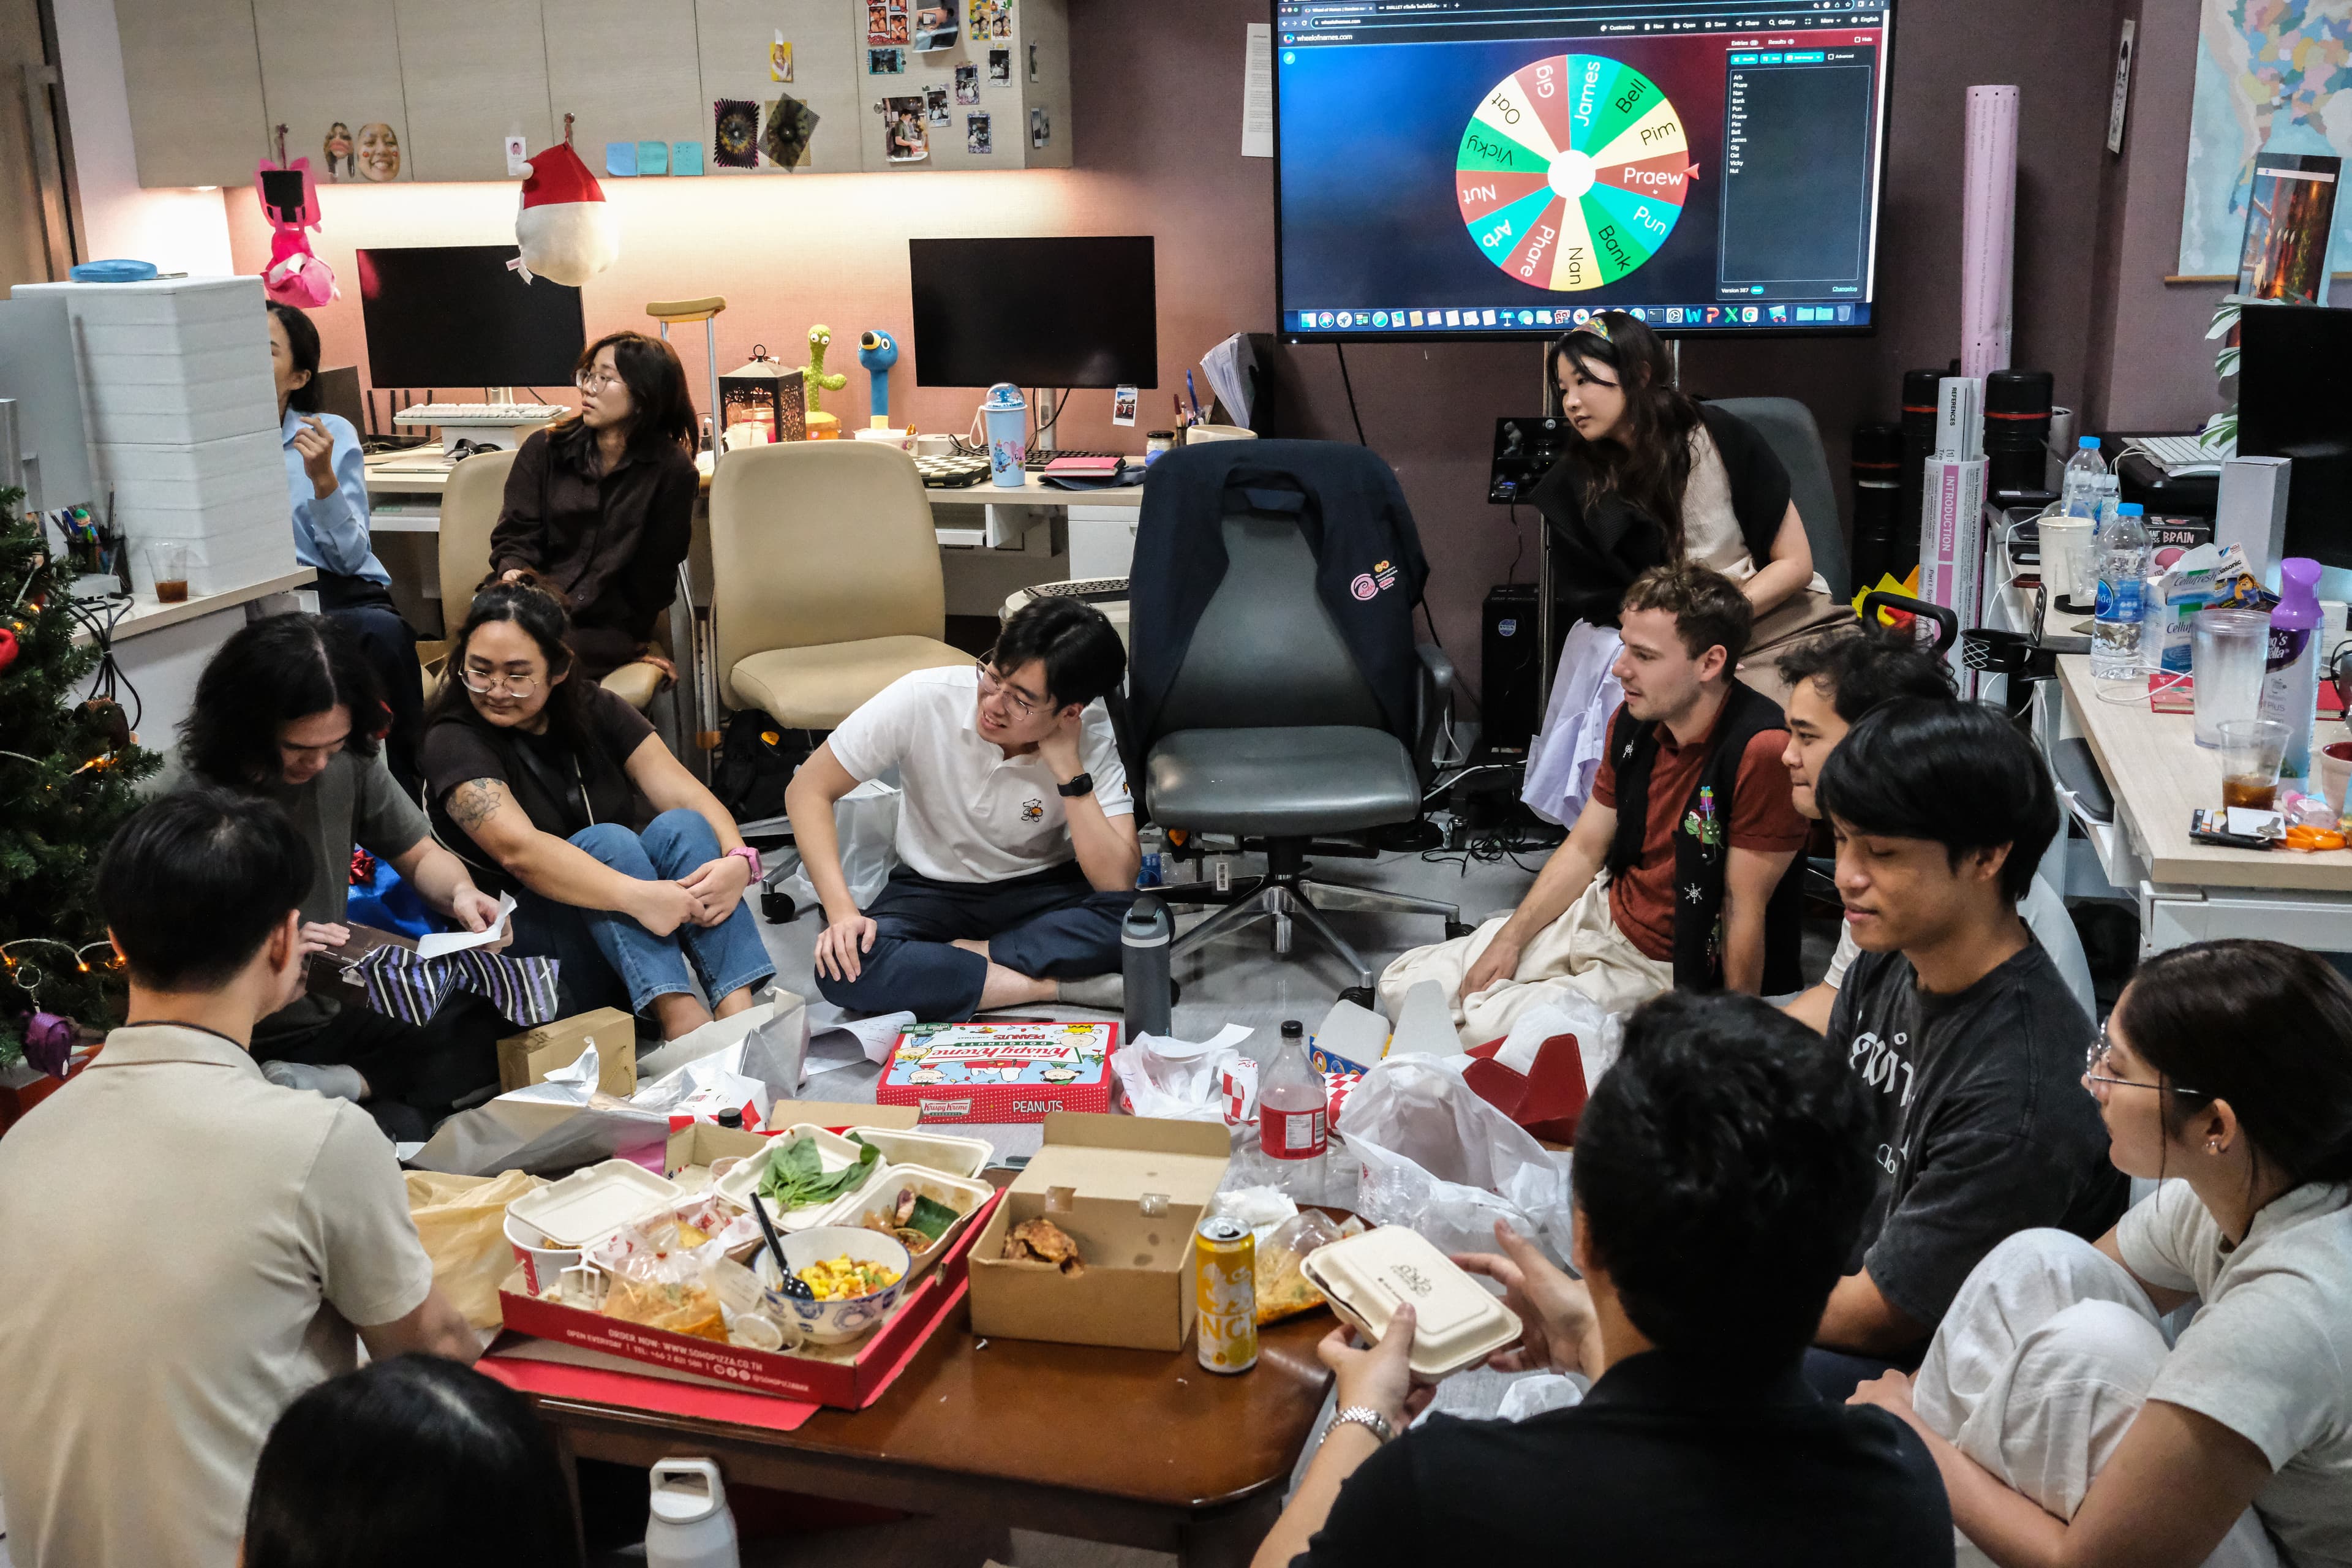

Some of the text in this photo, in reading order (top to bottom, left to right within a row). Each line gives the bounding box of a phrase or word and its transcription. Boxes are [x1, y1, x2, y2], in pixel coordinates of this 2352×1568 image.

[1536, 65, 1555, 98] Gig
[1574, 61, 1600, 127] James
[1615, 78, 1647, 113] Bell
[1491, 92, 1520, 124] Oat
[1641, 122, 1676, 145] Pim
[1467, 135, 1513, 166] Vicky
[1624, 167, 1683, 186] Praew
[1463, 184, 1496, 204] Nut
[1634, 206, 1666, 235] Pun
[1483, 219, 1512, 247] Arb
[1520, 225, 1555, 277] Phare
[1599, 225, 1631, 271] Bank
[1569, 247, 1583, 284] Nan
[1946, 449, 1954, 458] [1]
[1941, 475, 1955, 552] INTRODUCTION
[2163, 531, 2194, 544] BRAIN
[2218, 558, 2242, 573] asonic
[2174, 571, 2217, 586] Cellufresh
[2268, 633, 2288, 650] ng's
[2268, 648, 2285, 660] ella
[931, 1046, 1071, 1059] Krispy Kreme
[924, 1103, 969, 1113] Krispy Kreme
[1012, 1100, 1063, 1113] PEANUTS
[567, 1329, 586, 1340] OPEN
[587, 1334, 622, 1349] EVERYDAY
[608, 1329, 636, 1342] ORDER
